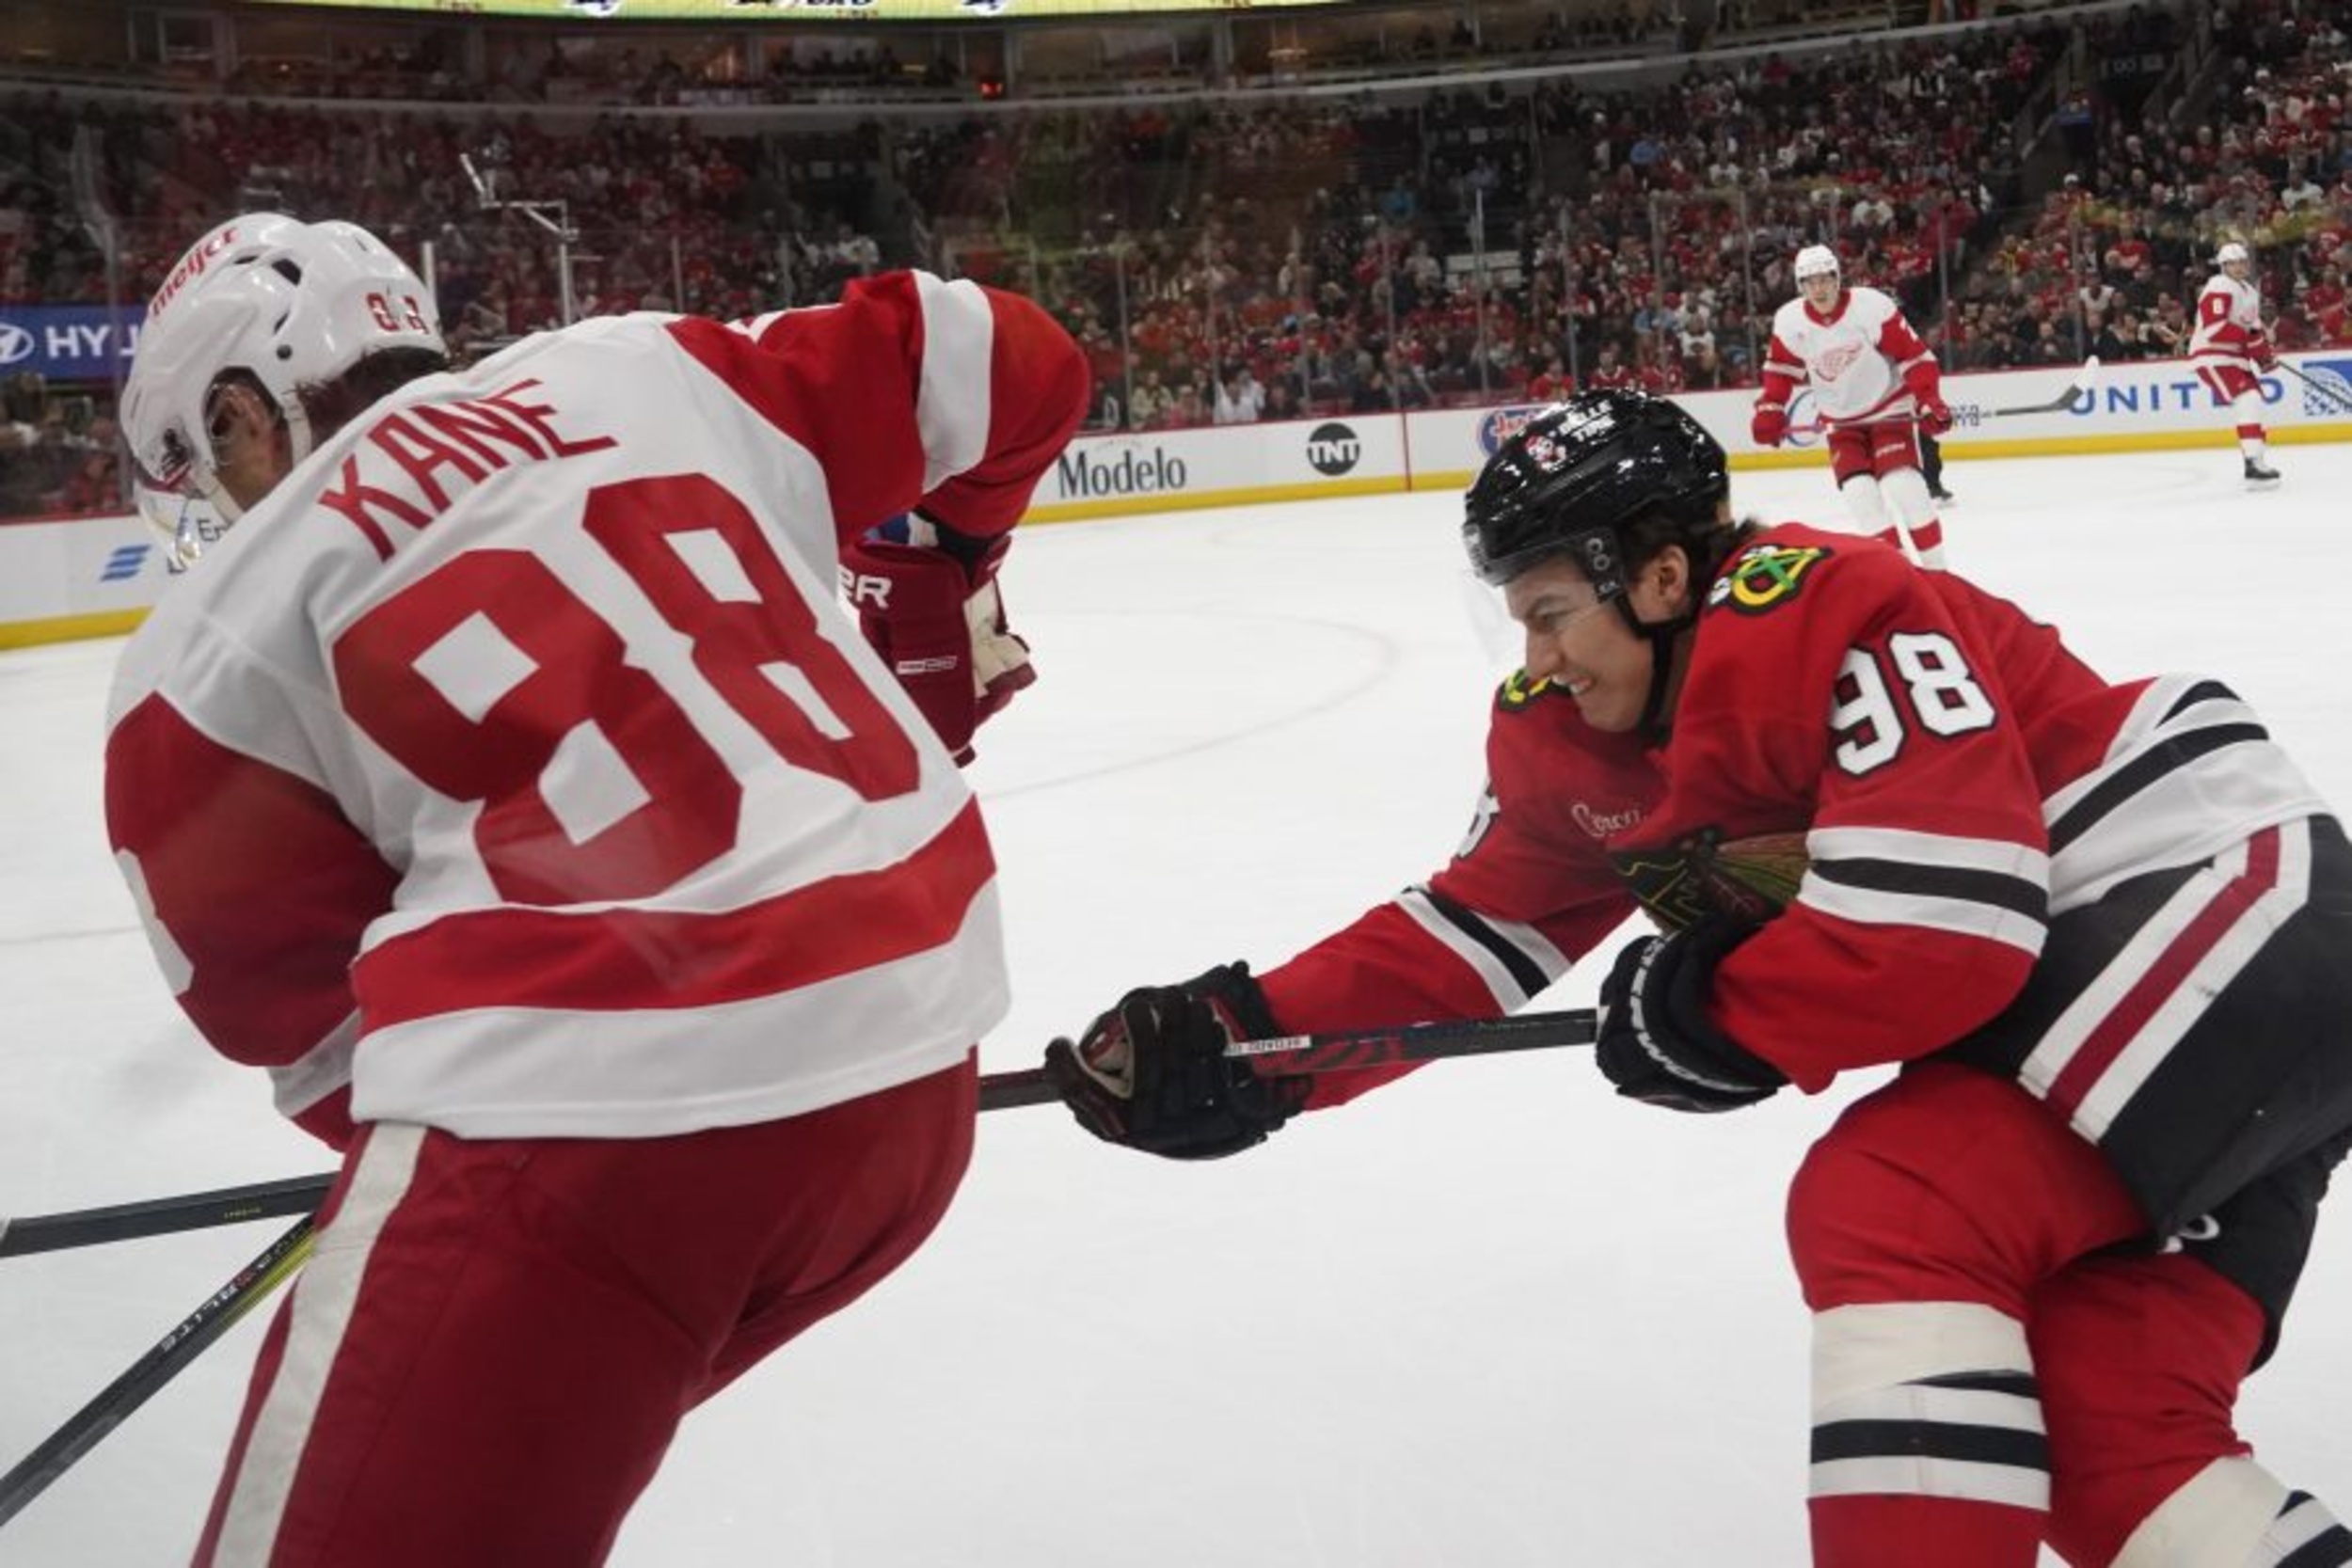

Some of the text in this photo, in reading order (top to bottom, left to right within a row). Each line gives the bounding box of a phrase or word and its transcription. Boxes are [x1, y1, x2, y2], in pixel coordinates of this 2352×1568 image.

[318, 378, 620, 563] KANE
[1058, 446, 1186, 498] Modelo
[1307, 438, 1360, 464] TNT
[331, 471, 921, 904] 88
[1828, 629, 2000, 778] 98
